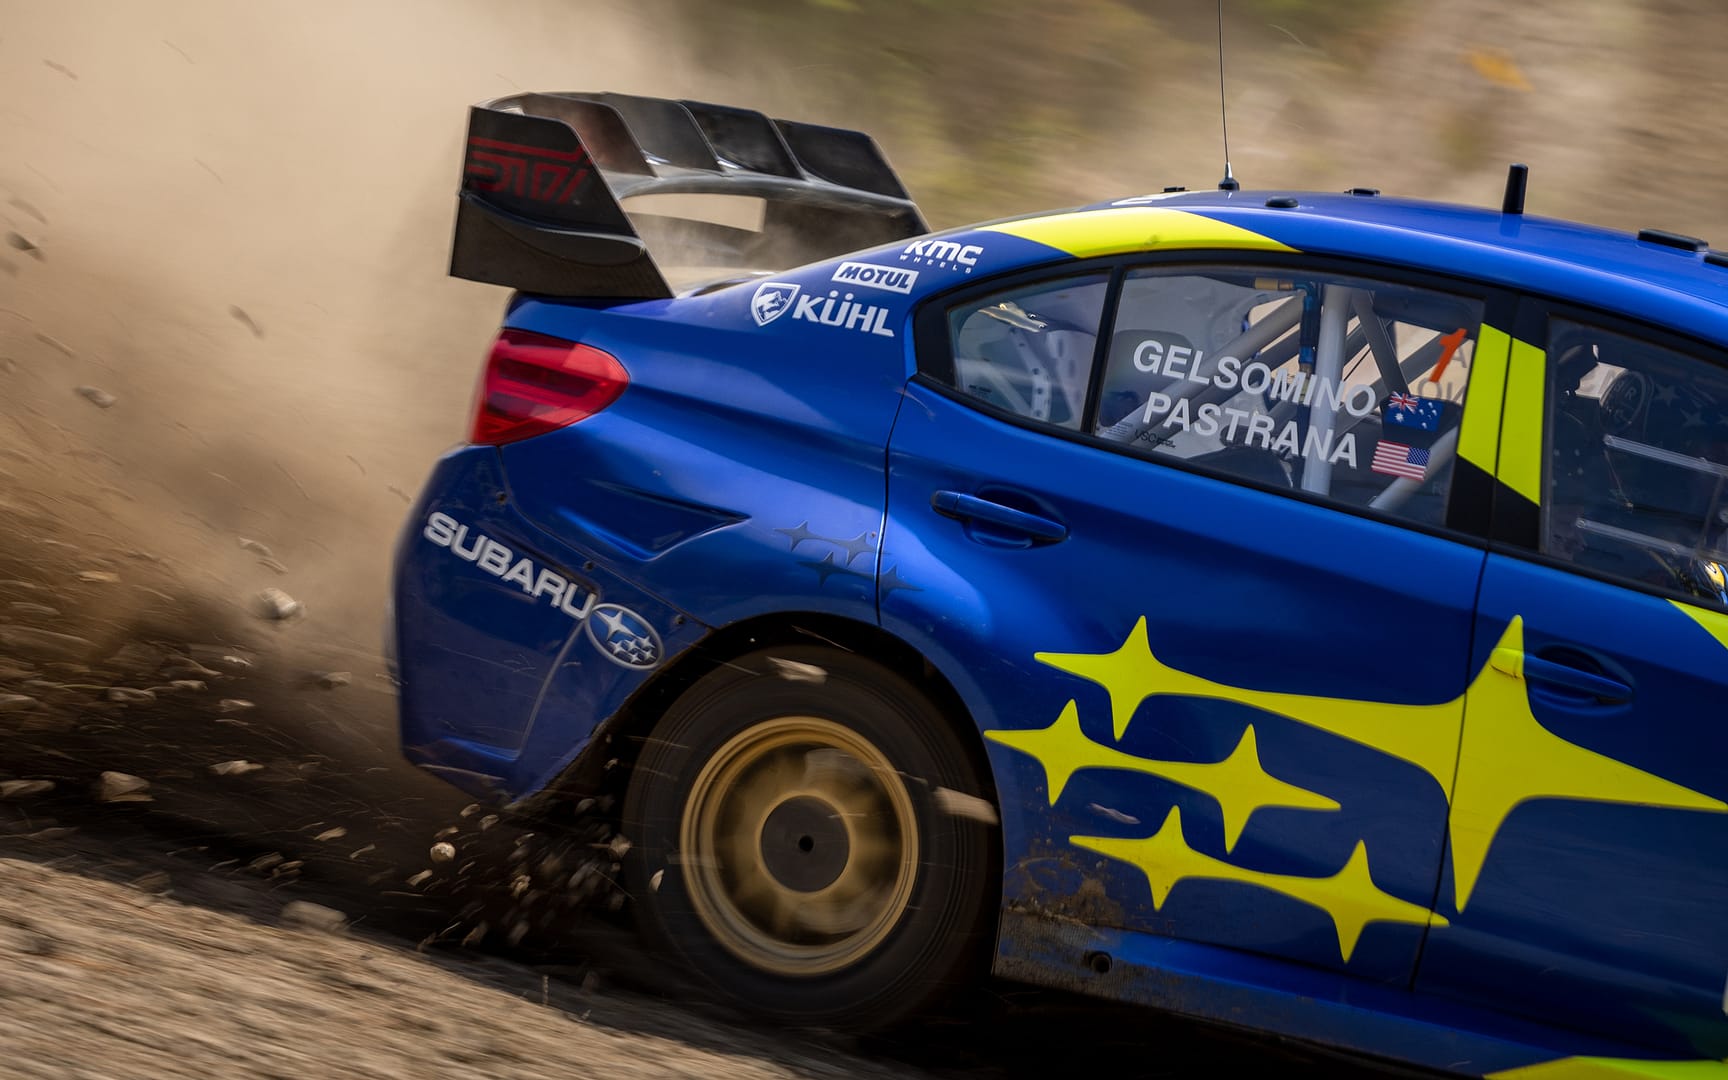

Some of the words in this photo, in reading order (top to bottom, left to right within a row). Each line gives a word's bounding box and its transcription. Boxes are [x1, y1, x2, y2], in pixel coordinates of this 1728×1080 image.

[838, 263, 912, 289] MOTUL
[899, 255, 973, 274] WHEELS
[792, 290, 895, 337] KÜHL
[1133, 340, 1377, 417] GELSOMINO
[1428, 327, 1468, 382] 1
[1143, 391, 1358, 469] PASTRANA
[423, 511, 597, 620] SUBARU
